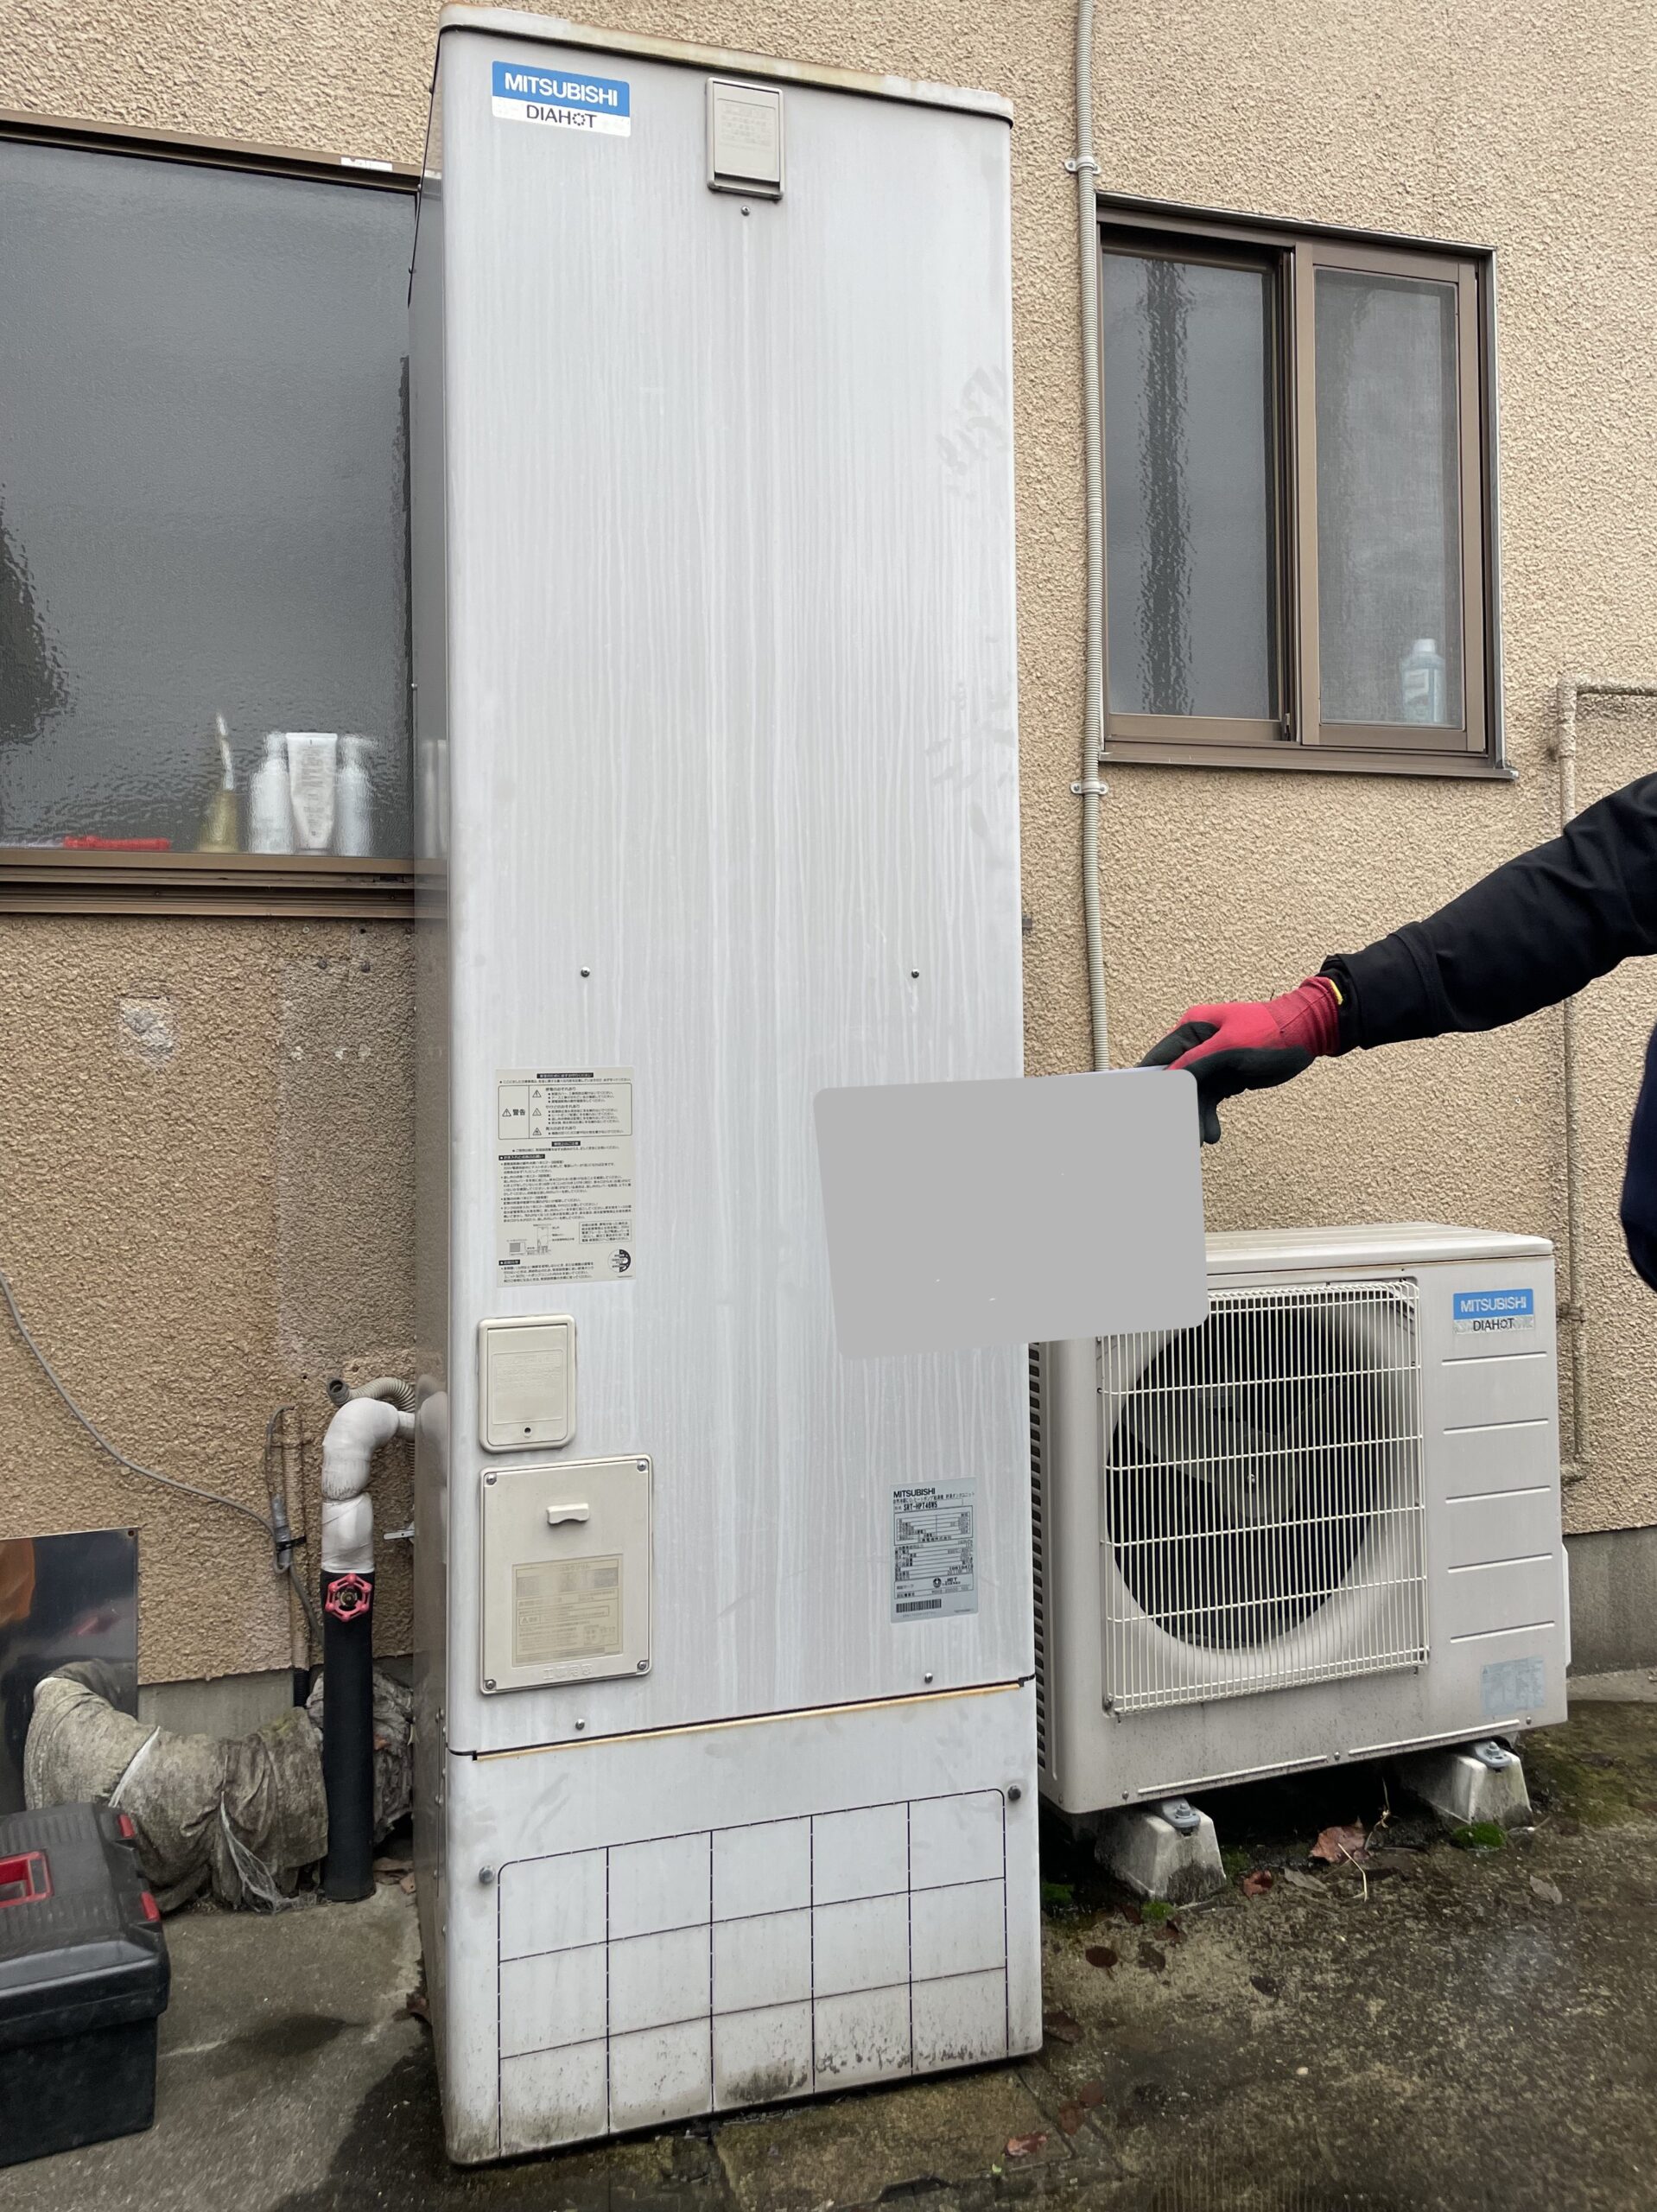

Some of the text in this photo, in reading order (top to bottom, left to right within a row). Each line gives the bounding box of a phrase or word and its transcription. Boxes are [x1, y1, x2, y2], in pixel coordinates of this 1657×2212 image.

[505, 73, 618, 106] MITSUBISHI
[526, 105, 597, 128] DIAHOT
[1460, 1296, 1527, 1313] MITSUBISHI
[1473, 1318, 1514, 1332] DIAHOT
[893, 1487, 936, 1498] MITSUBISHI
